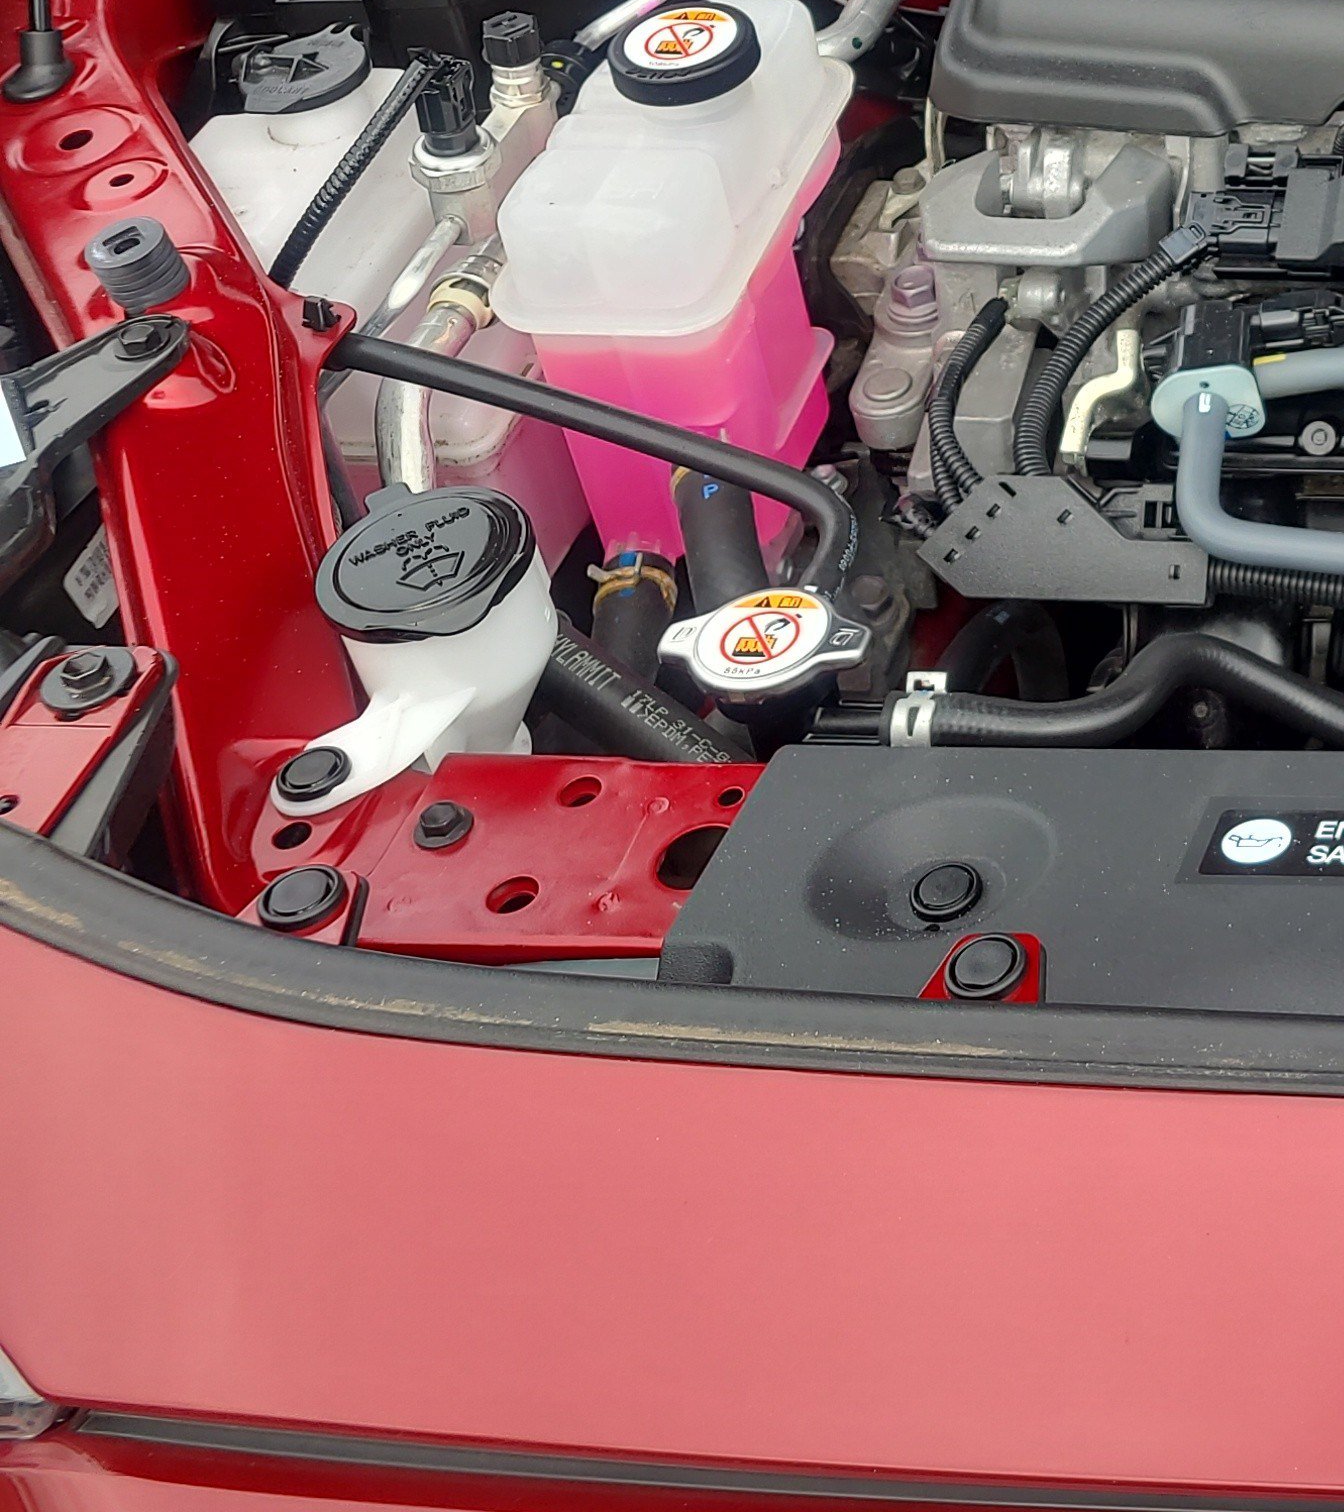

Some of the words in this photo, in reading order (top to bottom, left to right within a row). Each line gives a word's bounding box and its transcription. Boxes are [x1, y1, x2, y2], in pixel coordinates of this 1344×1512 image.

[349, 530, 419, 567] WASHER
[425, 507, 471, 532] FLUID
[396, 532, 435, 558] ONLY
